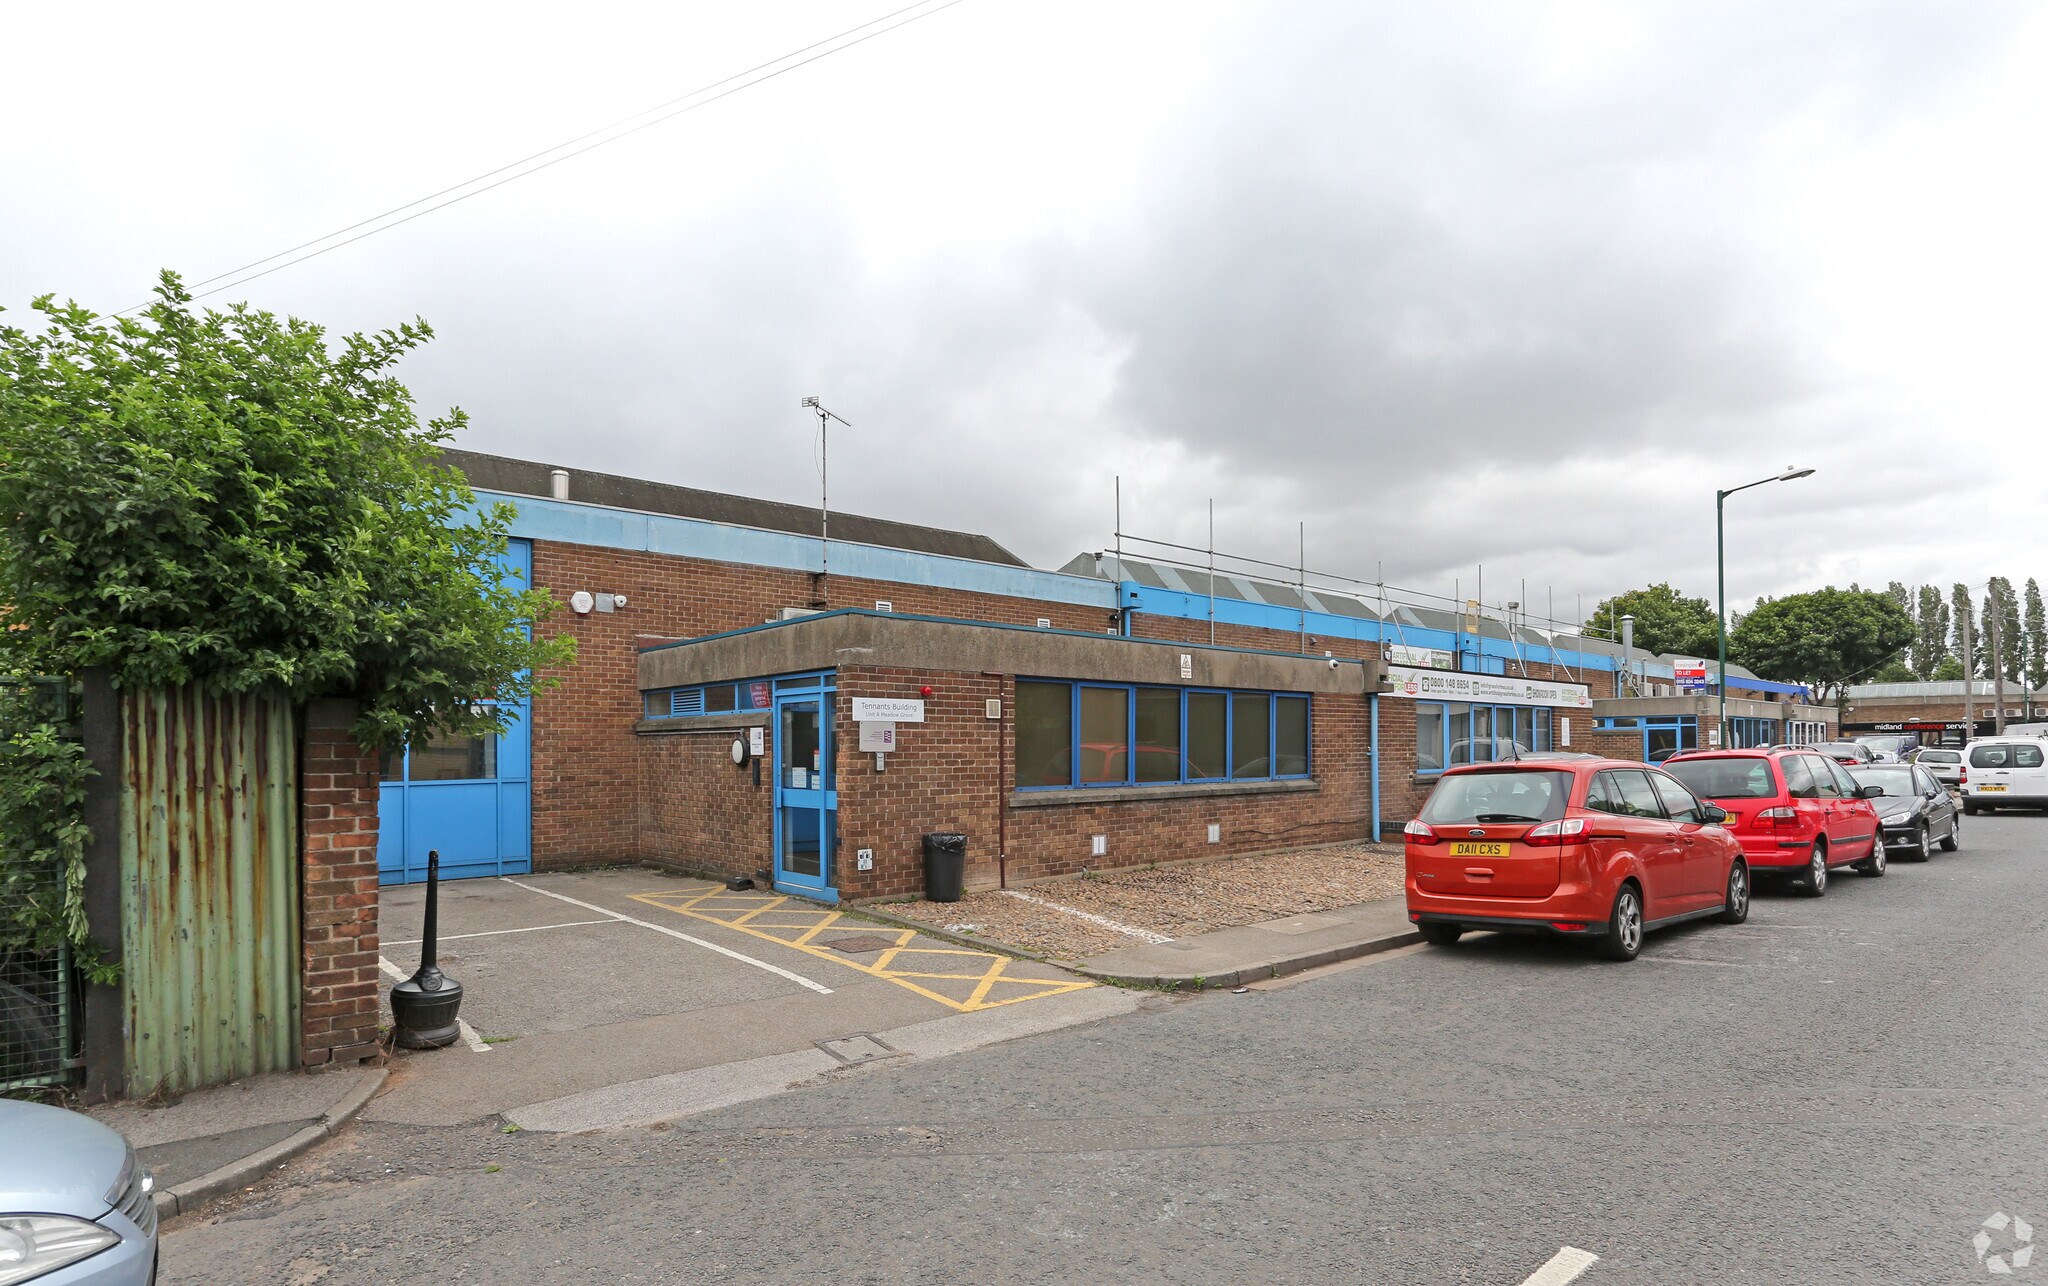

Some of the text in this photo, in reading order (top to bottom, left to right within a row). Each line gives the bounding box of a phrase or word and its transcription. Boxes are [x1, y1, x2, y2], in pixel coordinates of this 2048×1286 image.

[1393, 651, 1417, 660] ARTIFIIAL
[1405, 682, 1418, 692] LESS
[1430, 677, 1444, 688] 0800
[1445, 678, 1455, 689] 148
[861, 702, 917, 713] Tennants Building
[1945, 722, 1978, 730] servics
[1457, 844, 1501, 855] DA11 CXS
